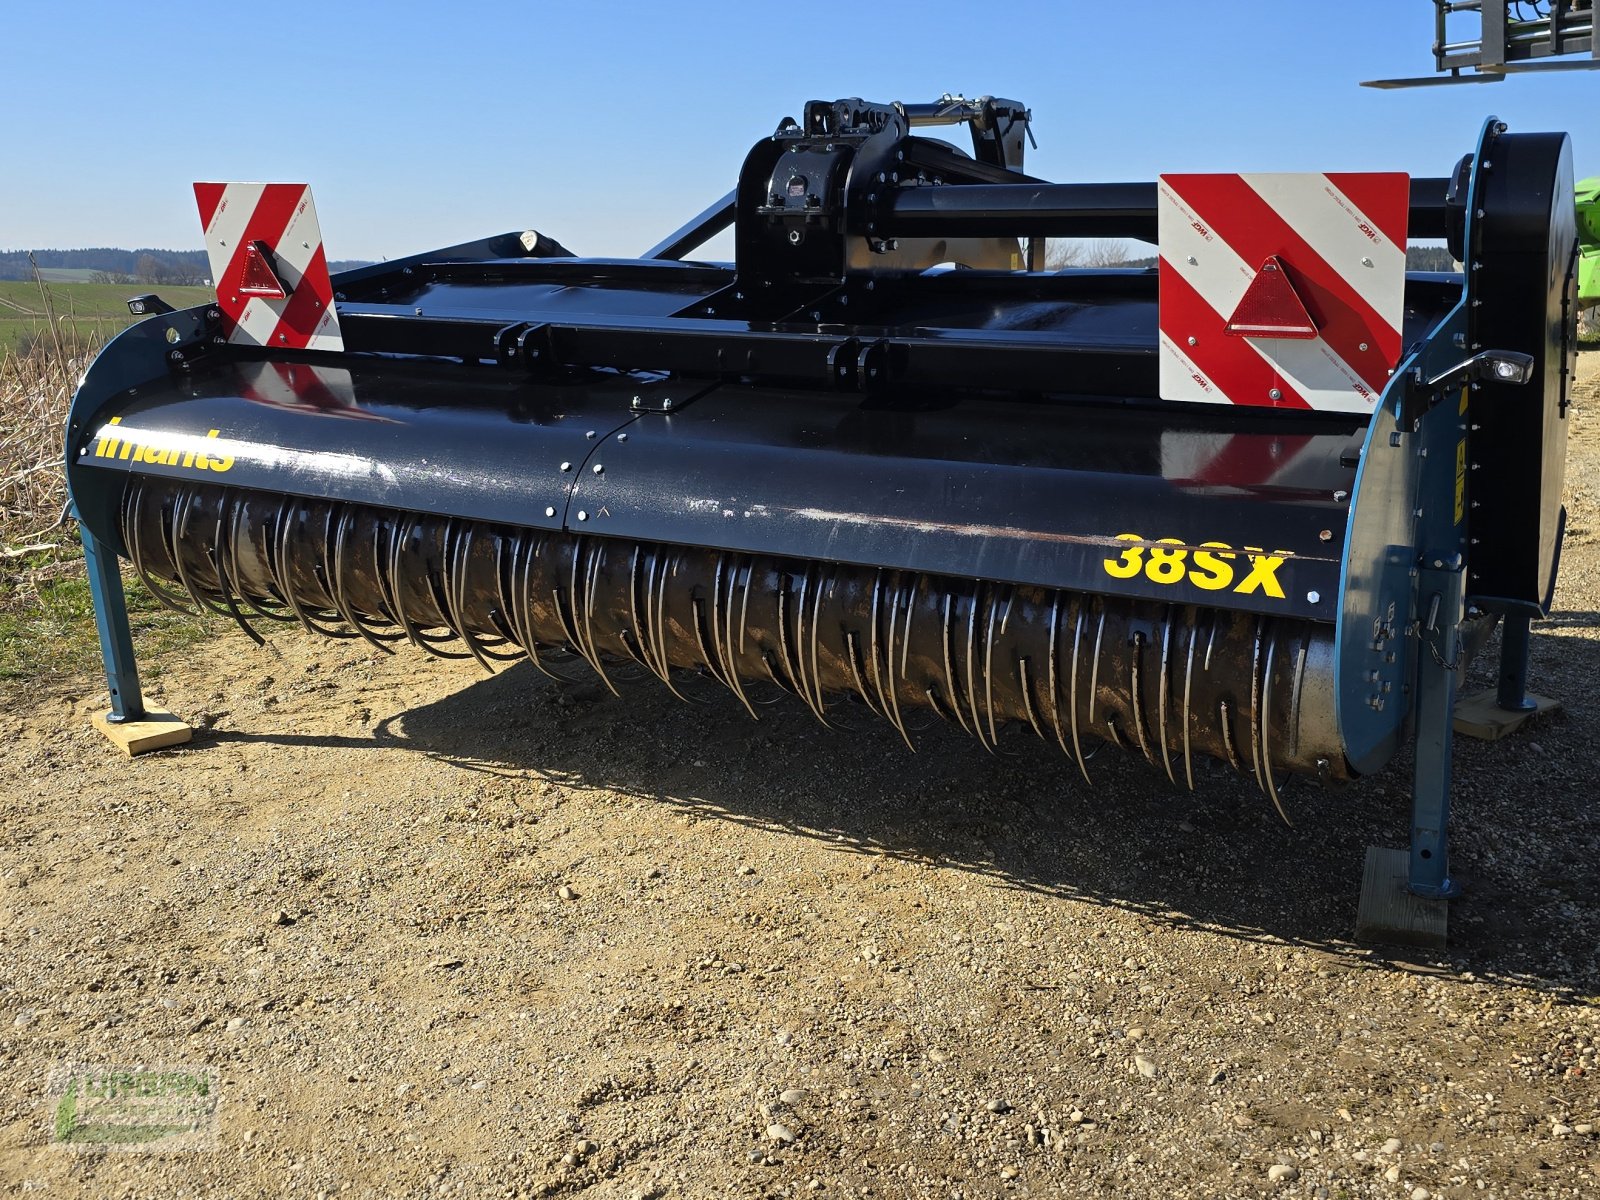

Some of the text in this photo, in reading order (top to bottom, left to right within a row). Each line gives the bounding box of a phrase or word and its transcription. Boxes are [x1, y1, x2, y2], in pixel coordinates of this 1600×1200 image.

[1191, 222, 1208, 237] WGF
[1357, 223, 1376, 239] WGF
[1191, 374, 1207, 388] WGF
[1352, 383, 1370, 398] WGF
[1103, 533, 1295, 599] 38SX
